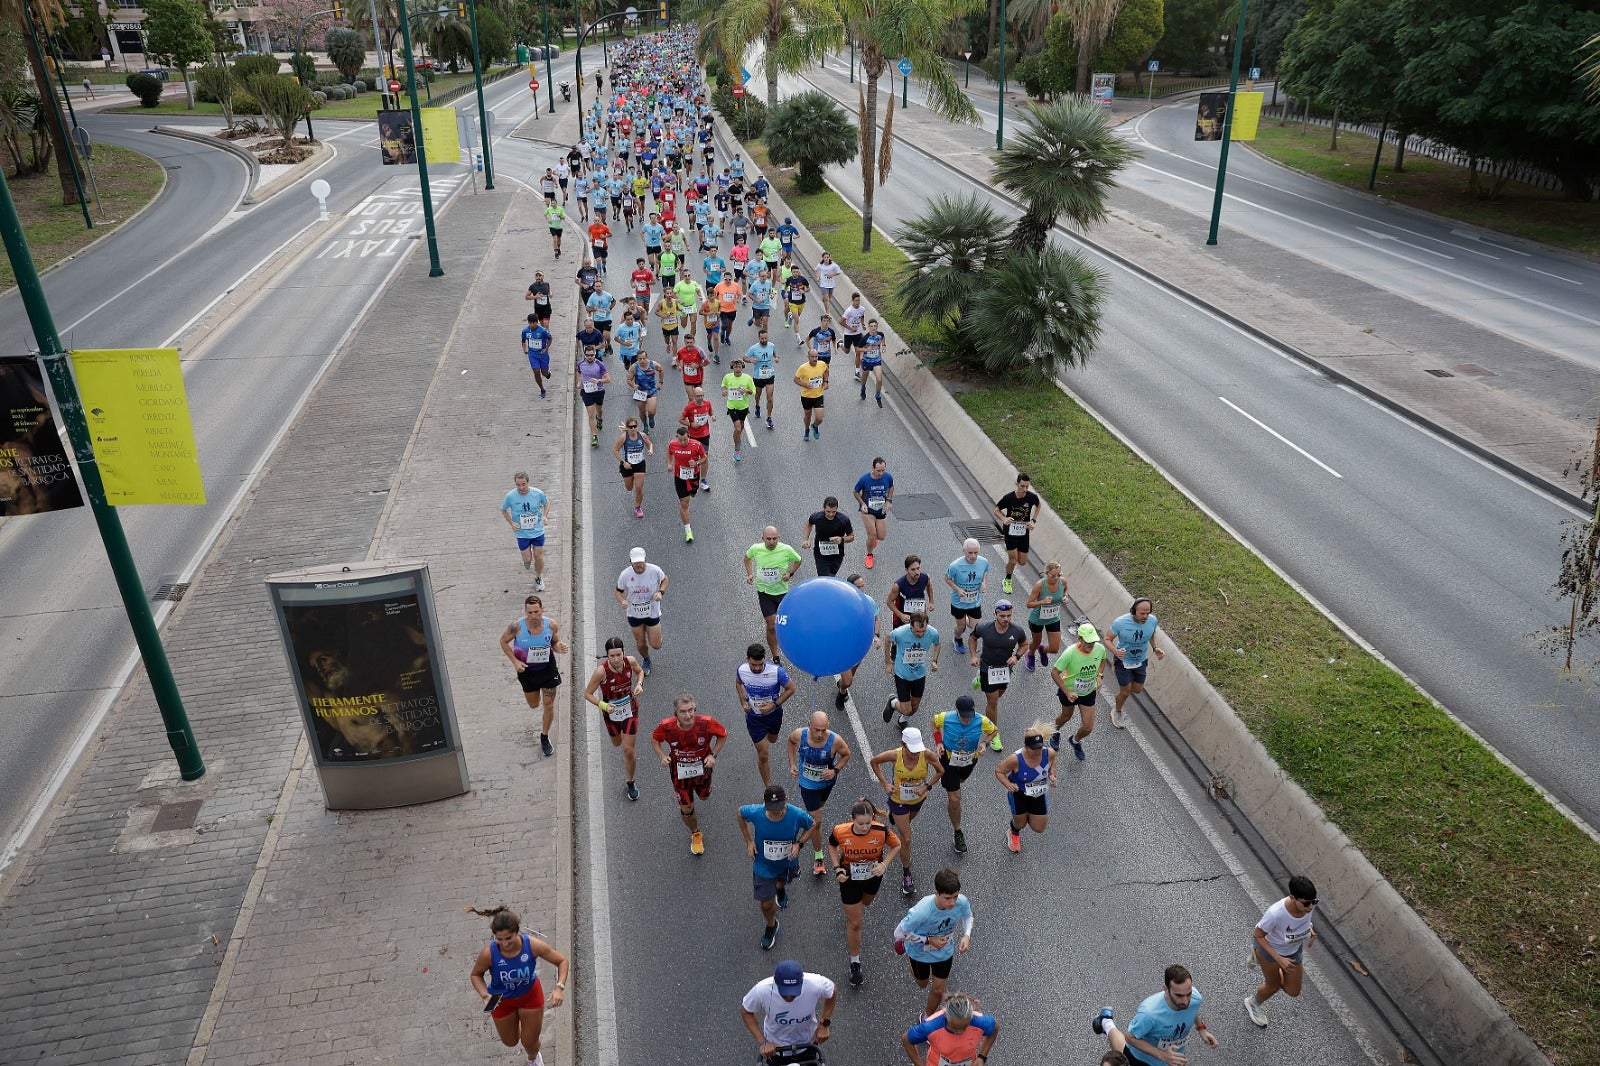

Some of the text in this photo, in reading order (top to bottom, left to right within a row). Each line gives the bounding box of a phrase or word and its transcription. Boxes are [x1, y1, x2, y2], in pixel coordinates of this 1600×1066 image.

[349, 218, 416, 235] BUS
[316, 239, 401, 258] TAXI
[136, 384, 173, 392] MURILLO
[21, 472, 70, 486] BARROCA
[312, 694, 386, 706] FIERAMENTE
[315, 695, 435, 718] HUMANOS RETRATOS
[384, 707, 438, 724] SANTIDAD
[386, 718, 441, 734] BARROCA
[499, 966, 530, 982] RCM
[775, 1010, 812, 1025] Forus
